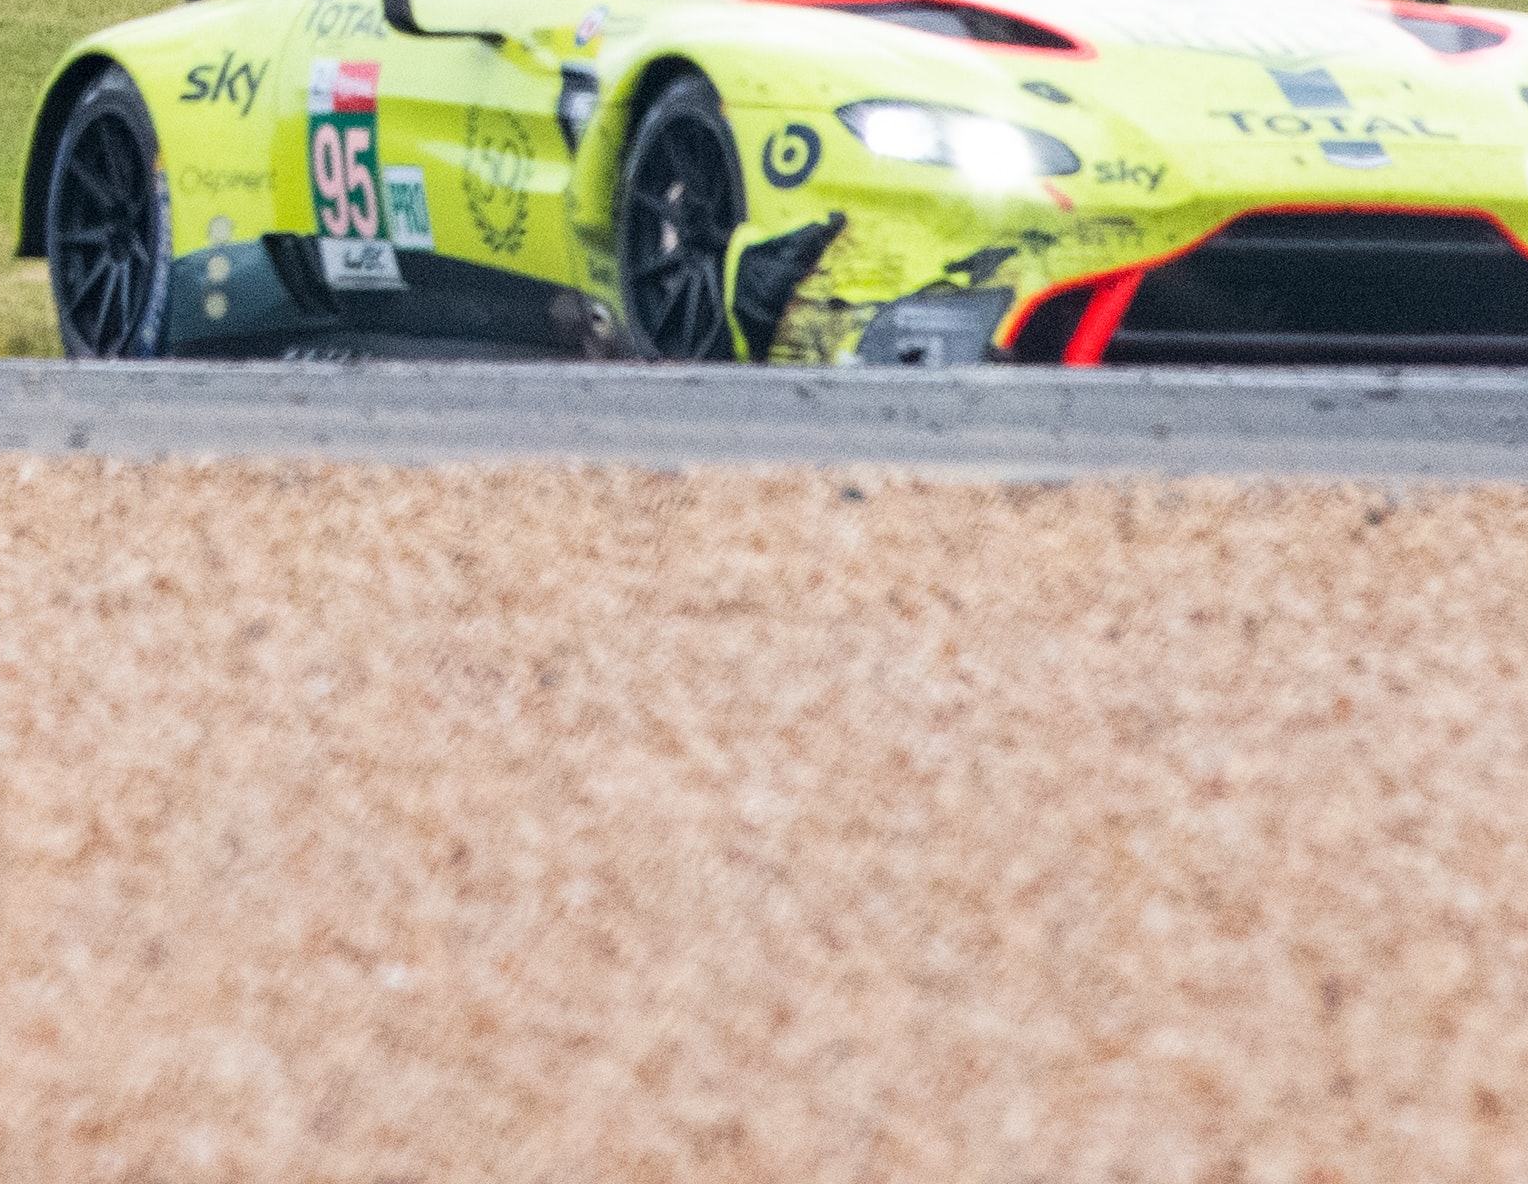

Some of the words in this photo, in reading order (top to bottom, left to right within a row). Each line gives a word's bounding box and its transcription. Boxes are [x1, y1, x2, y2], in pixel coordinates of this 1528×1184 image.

[179, 49, 271, 117] sky
[1207, 109, 1459, 140] TOTAL
[312, 123, 379, 239] 95
[1093, 157, 1168, 192] sky
[389, 181, 433, 236] PRO
